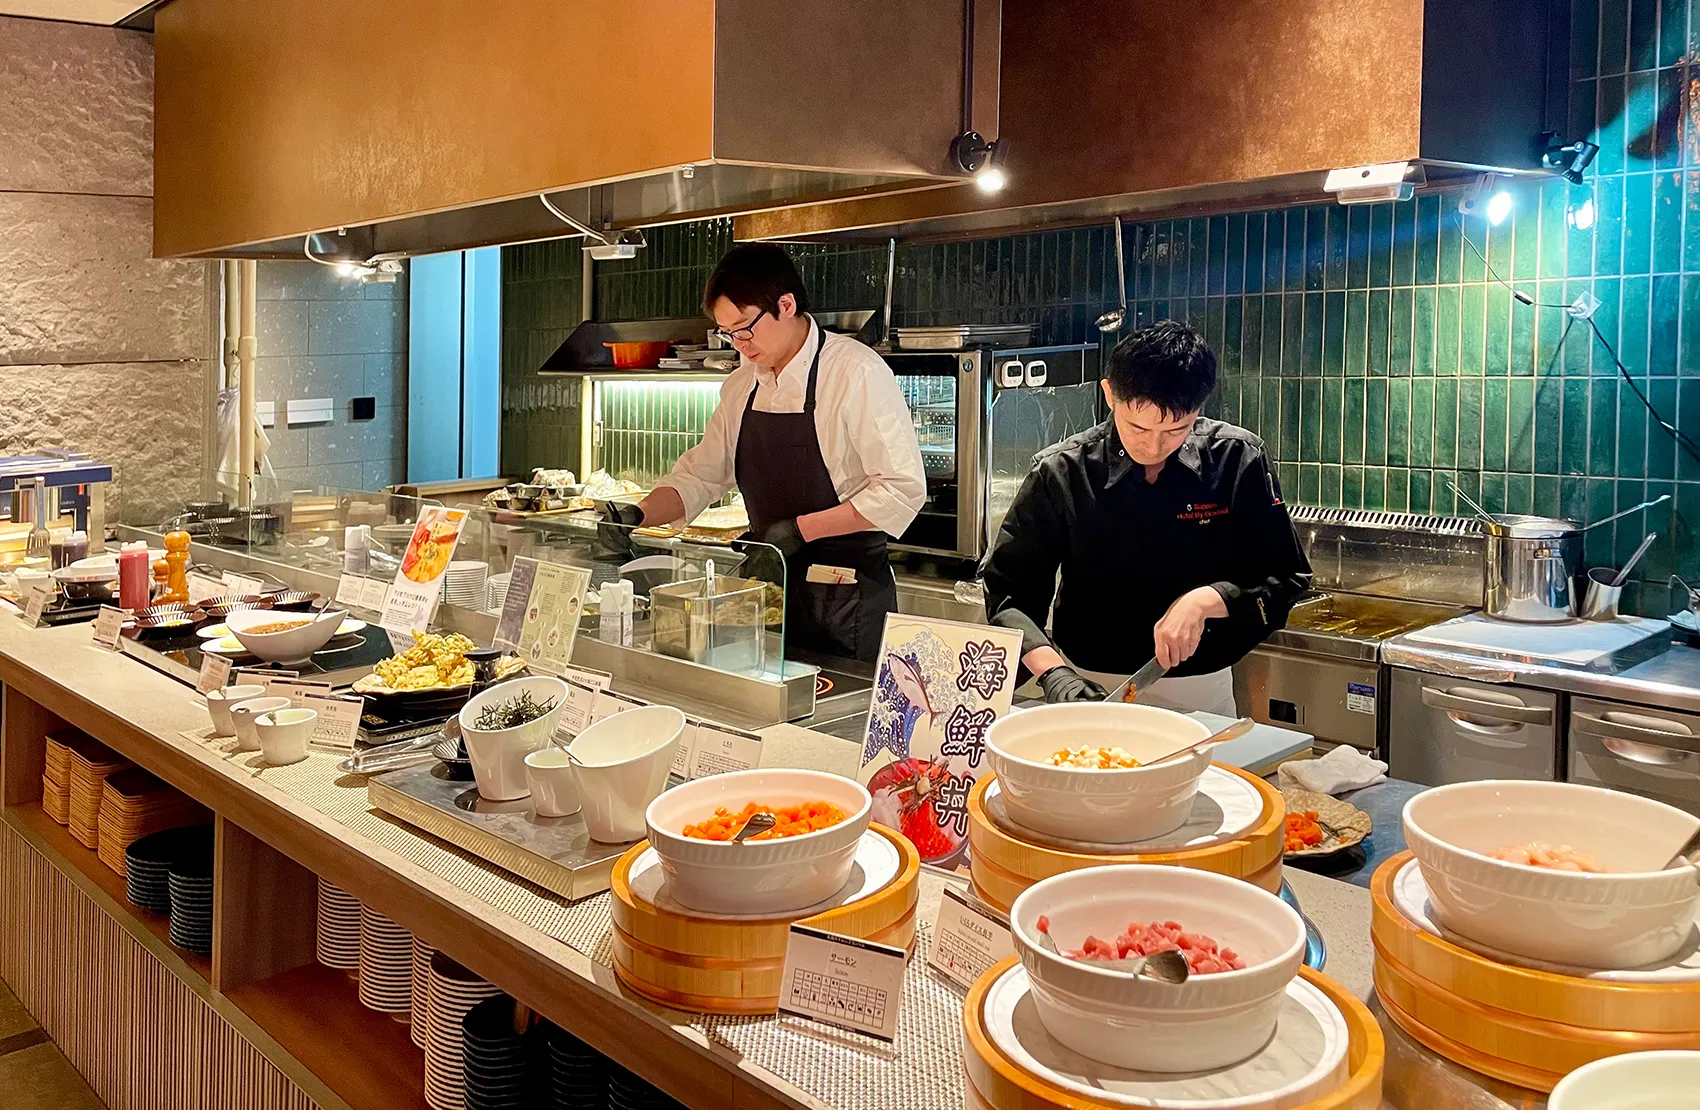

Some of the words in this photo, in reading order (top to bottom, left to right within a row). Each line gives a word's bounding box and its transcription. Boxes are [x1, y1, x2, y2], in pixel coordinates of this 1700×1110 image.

[936, 640, 1008, 837] 海鮮丼
[830, 952, 857, 966] サーモン
